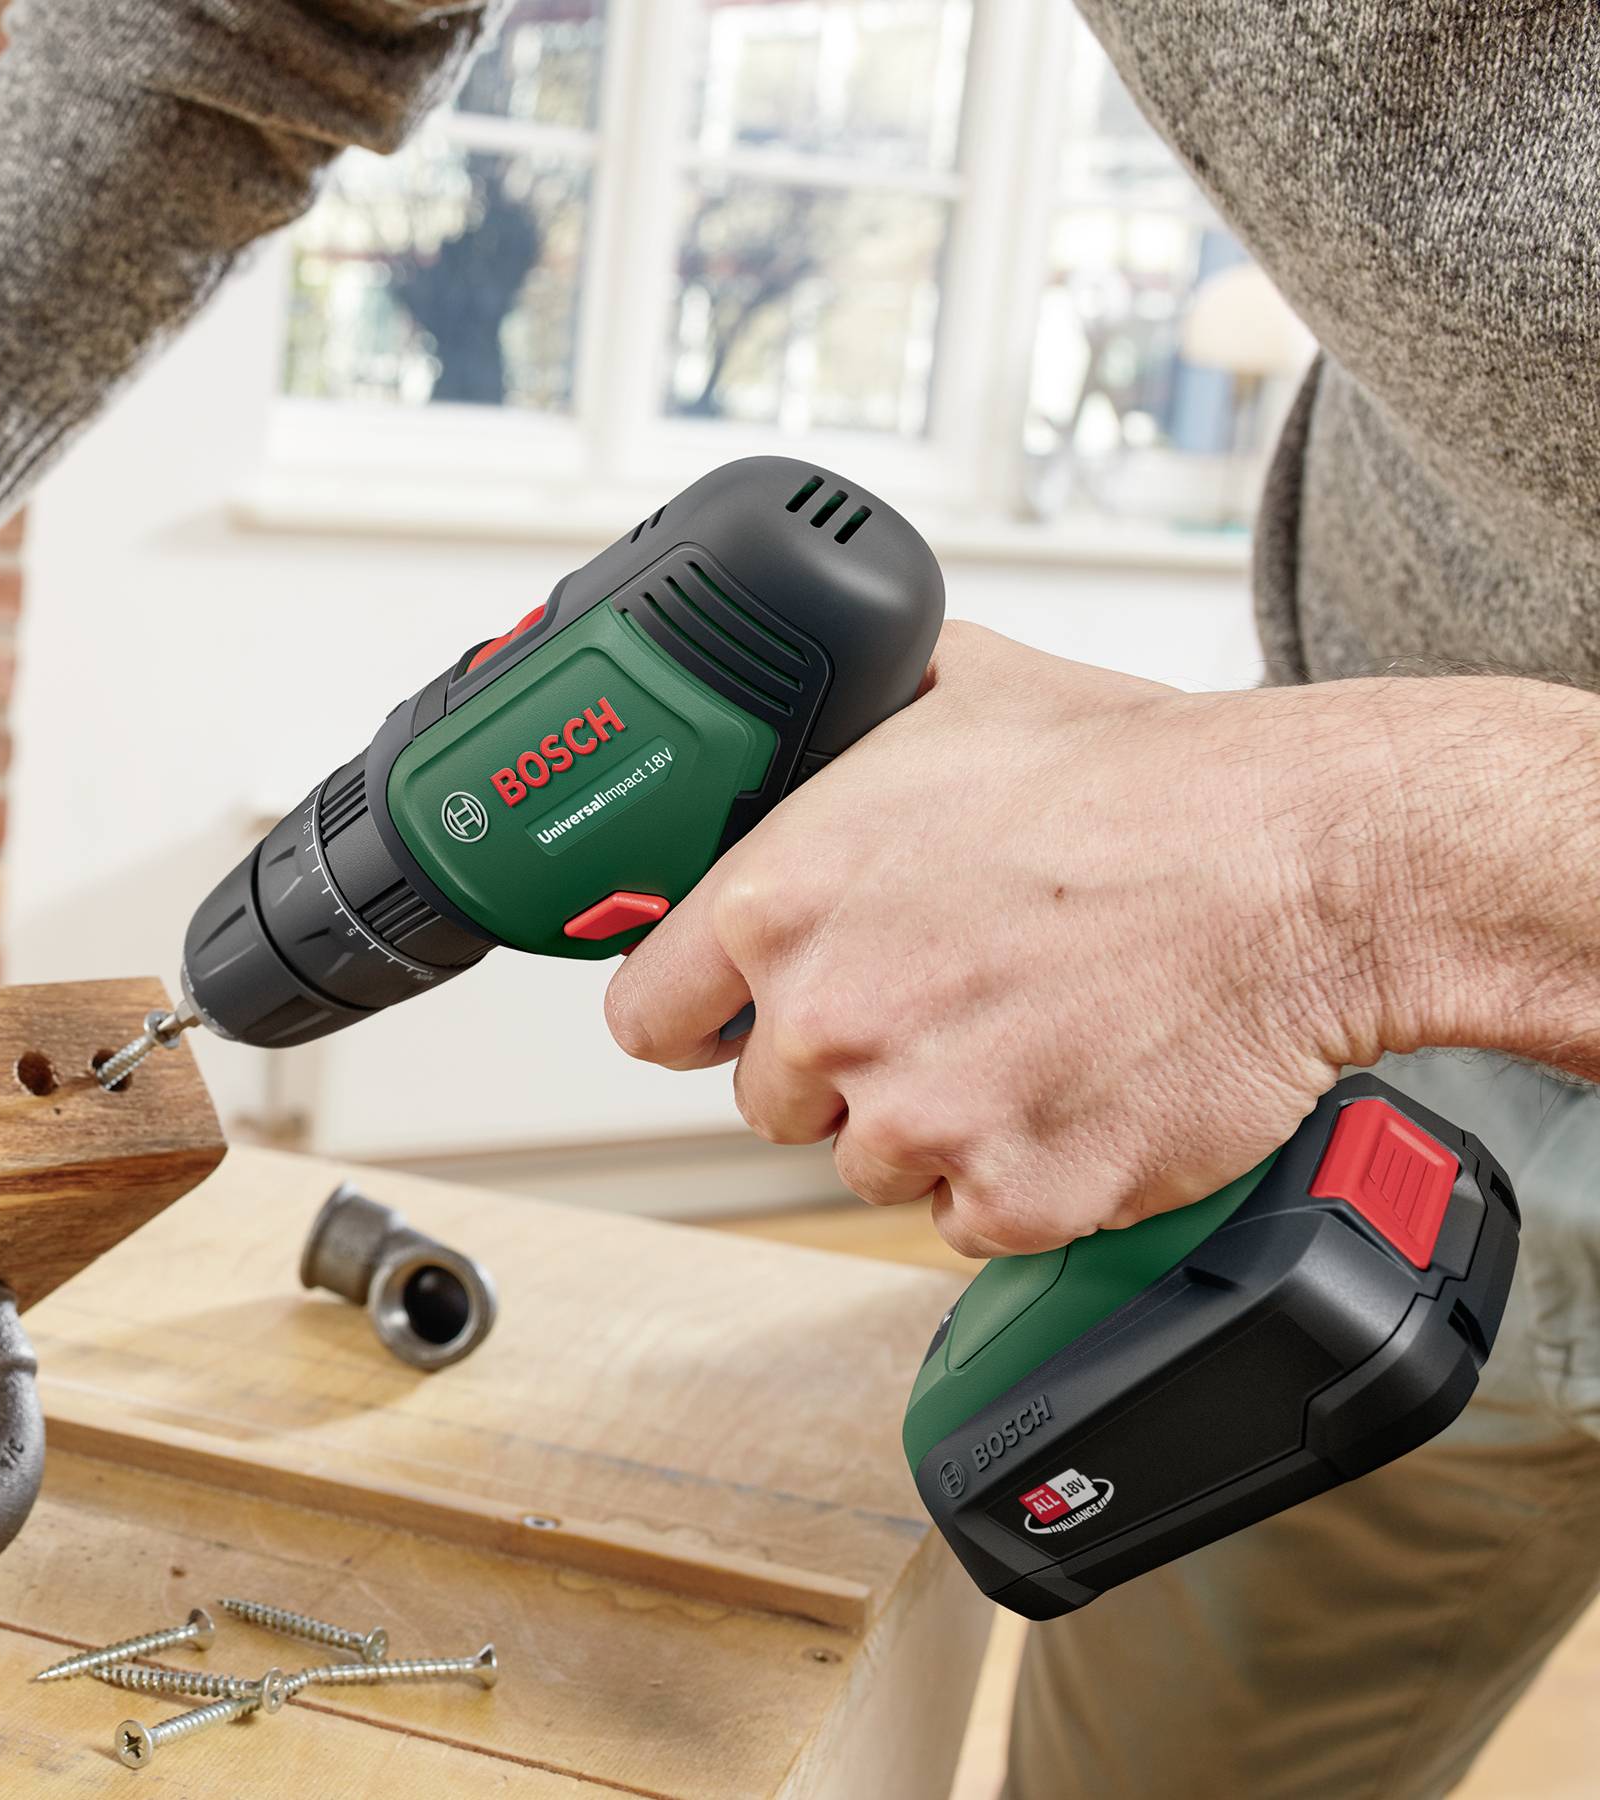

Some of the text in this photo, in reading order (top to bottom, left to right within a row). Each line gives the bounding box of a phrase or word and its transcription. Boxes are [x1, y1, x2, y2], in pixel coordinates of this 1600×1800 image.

[490, 697, 625, 808] BOSCH
[537, 747, 673, 844] UniversalImpact 18V
[345, 927, 357, 937] 5
[971, 1393, 1055, 1472] BOSCH
[1032, 1495, 1061, 1515] ALL
[1060, 1477, 1087, 1499] 18V
[1059, 1504, 1102, 1533] ALLIANCE
